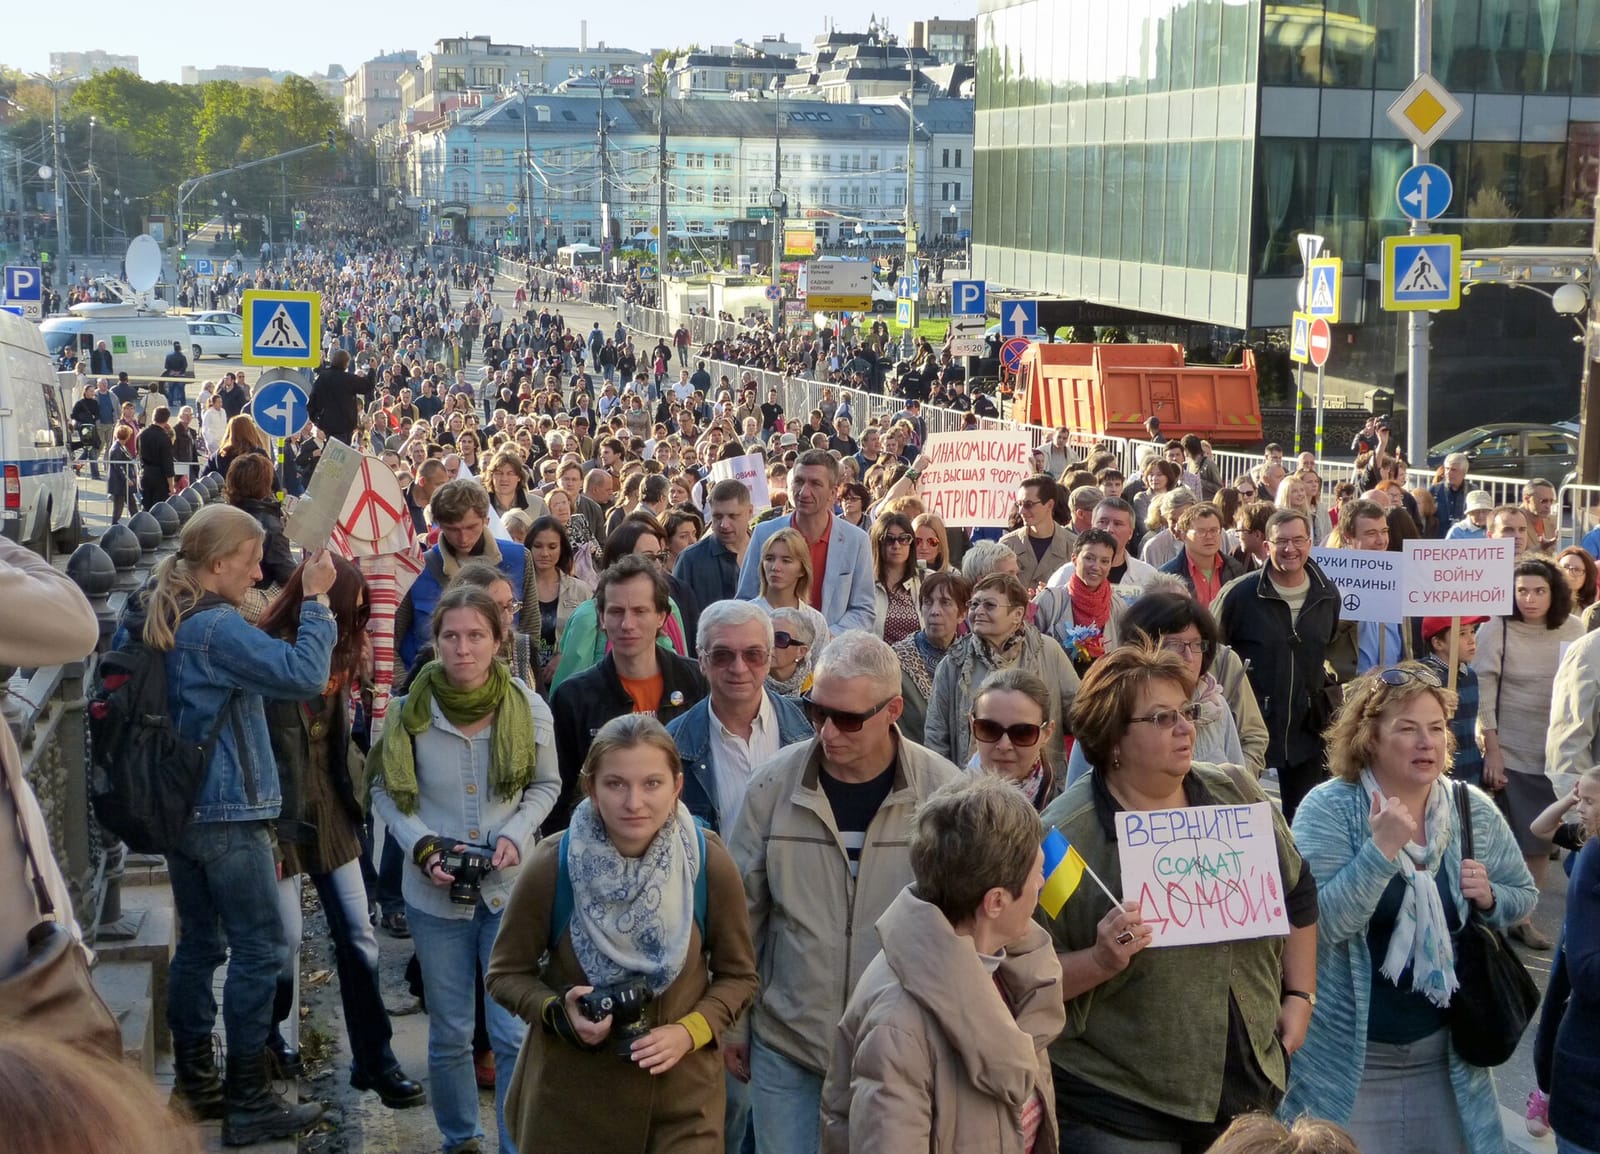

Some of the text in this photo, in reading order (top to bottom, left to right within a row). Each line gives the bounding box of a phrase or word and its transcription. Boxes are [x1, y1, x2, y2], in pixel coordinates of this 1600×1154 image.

[13, 270, 34, 297] P
[961, 284, 980, 311] P
[27, 306, 38, 314] 20
[131, 339, 173, 348] TELEVISION
[972, 344, 983, 353] 20
[929, 440, 1026, 464] ИНАКОМЫСЛИЕ
[943, 468, 986, 483] ВЫСШАЯ
[1412, 547, 1504, 561] ПРЕКРАТИТЕ
[1316, 556, 1393, 571] РУКИ ПРОЧЬ
[1433, 567, 1483, 583] ВОЙНУ
[1329, 576, 1396, 591] УКРАИНЫ!
[1408, 587, 1506, 603] С УКРАИНОЙ!
[1125, 806, 1253, 847] ВЕРНИТЕ
[1157, 851, 1245, 880] СОЛДАТ
[1138, 865, 1282, 935] ДОМОЙ!
